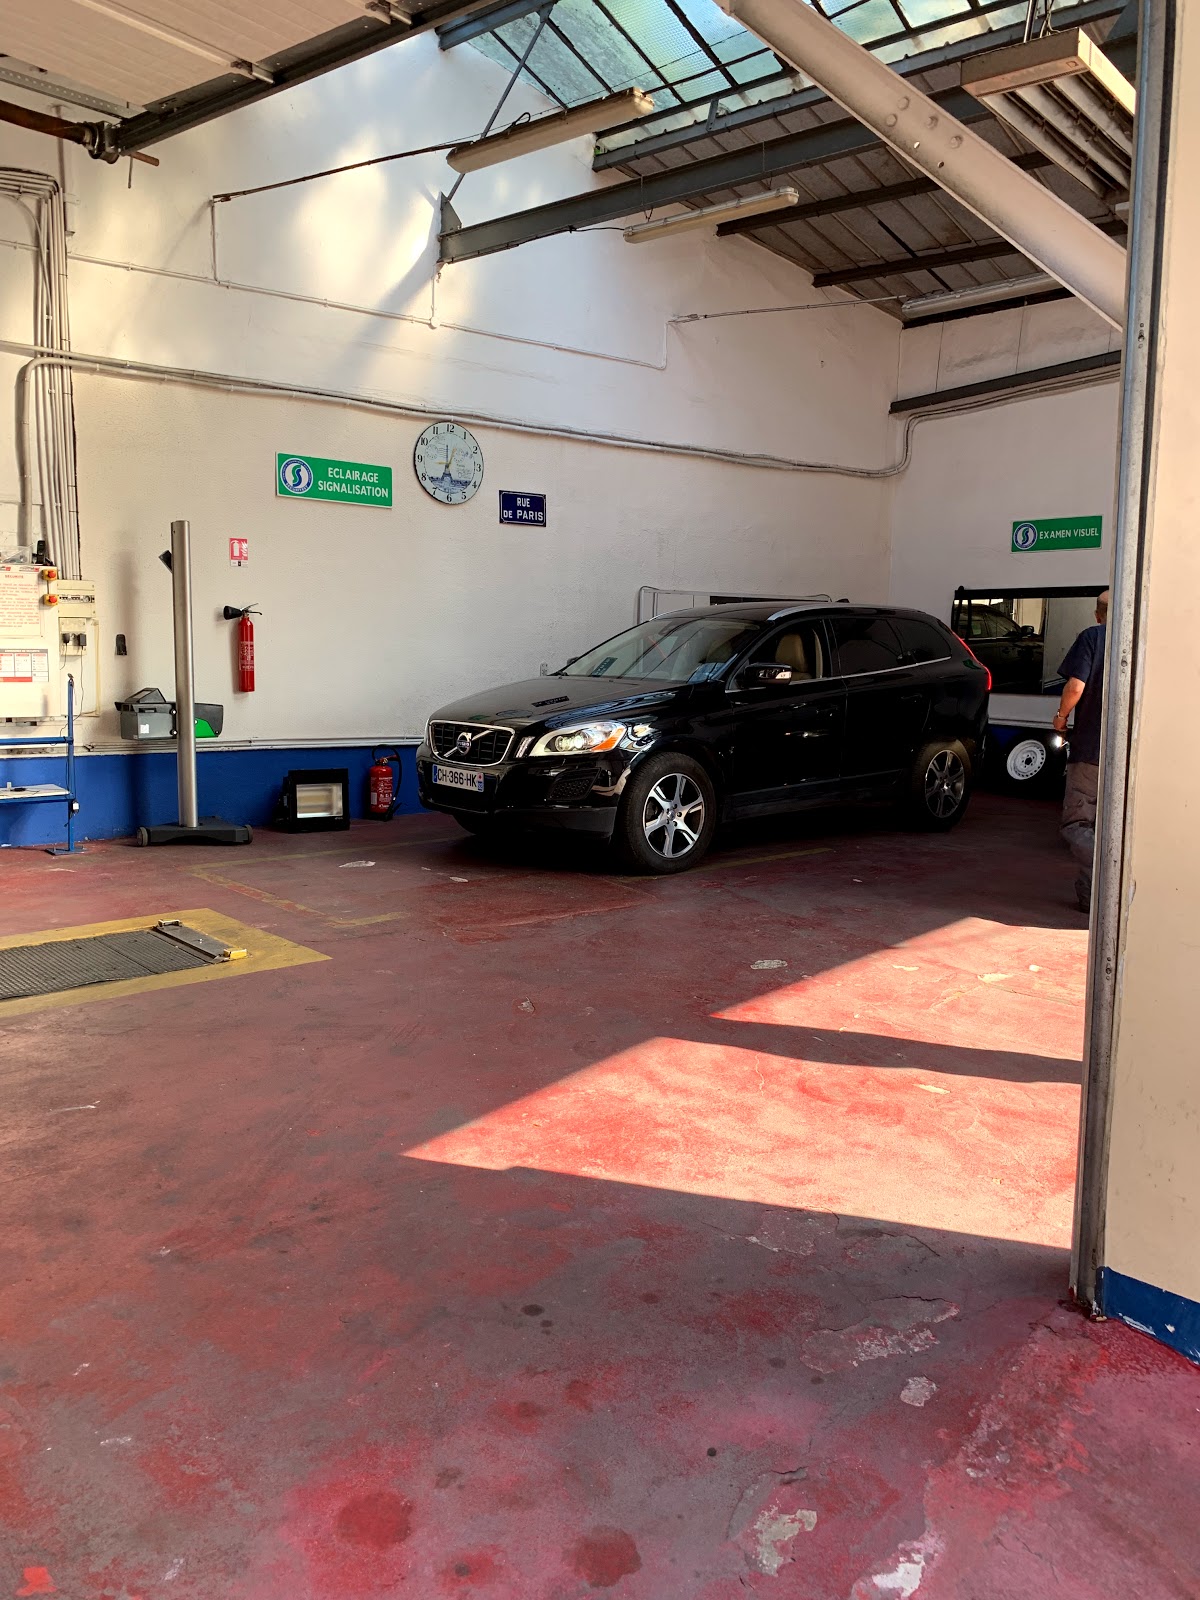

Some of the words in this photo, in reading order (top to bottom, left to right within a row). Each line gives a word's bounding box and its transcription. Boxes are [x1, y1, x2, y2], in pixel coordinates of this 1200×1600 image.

[433, 426, 438, 434] 11
[447, 424, 454, 432] 12
[421, 437, 428, 446] 10
[473, 446, 478, 454] 2
[476, 464, 481, 472] 3
[328, 467, 378, 483] ECLAIRAGE
[421, 473, 426, 481] 8
[318, 480, 388, 498] SIGNALISATION
[432, 487, 437, 495] 7
[447, 494, 452, 502] 6
[462, 492, 466, 500] 5
[517, 498, 530, 507] RUE
[503, 510, 512, 518] DE
[517, 510, 544, 521] PARIS
[1040, 529, 1072, 539] EXAMEN
[1073, 528, 1099, 537] VISUEL
[437, 768, 477, 787] CH-366-HK
